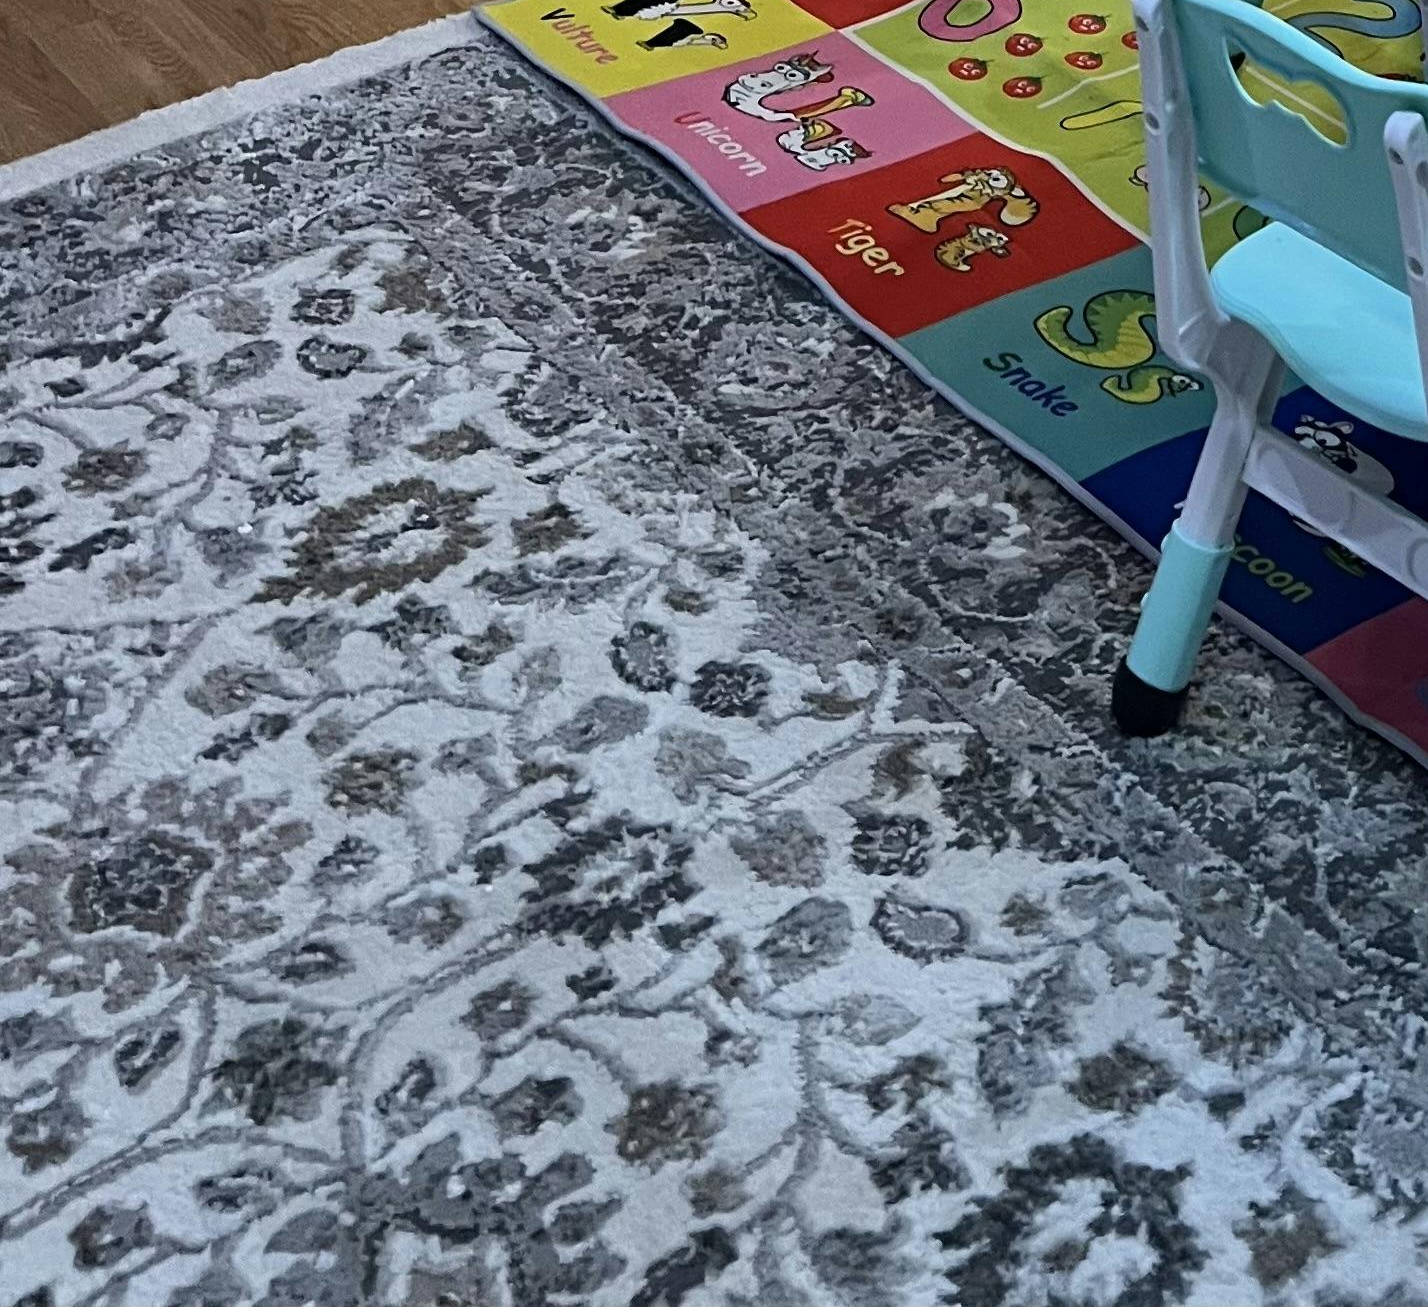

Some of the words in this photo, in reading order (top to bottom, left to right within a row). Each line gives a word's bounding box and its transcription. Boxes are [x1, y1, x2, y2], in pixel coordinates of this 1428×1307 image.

[541, 7, 619, 65] Vulture
[673, 111, 768, 177] Unicorn
[828, 218, 905, 277] Tiger
[982, 351, 1079, 418] Snake
[1231, 542, 1315, 604] coon
